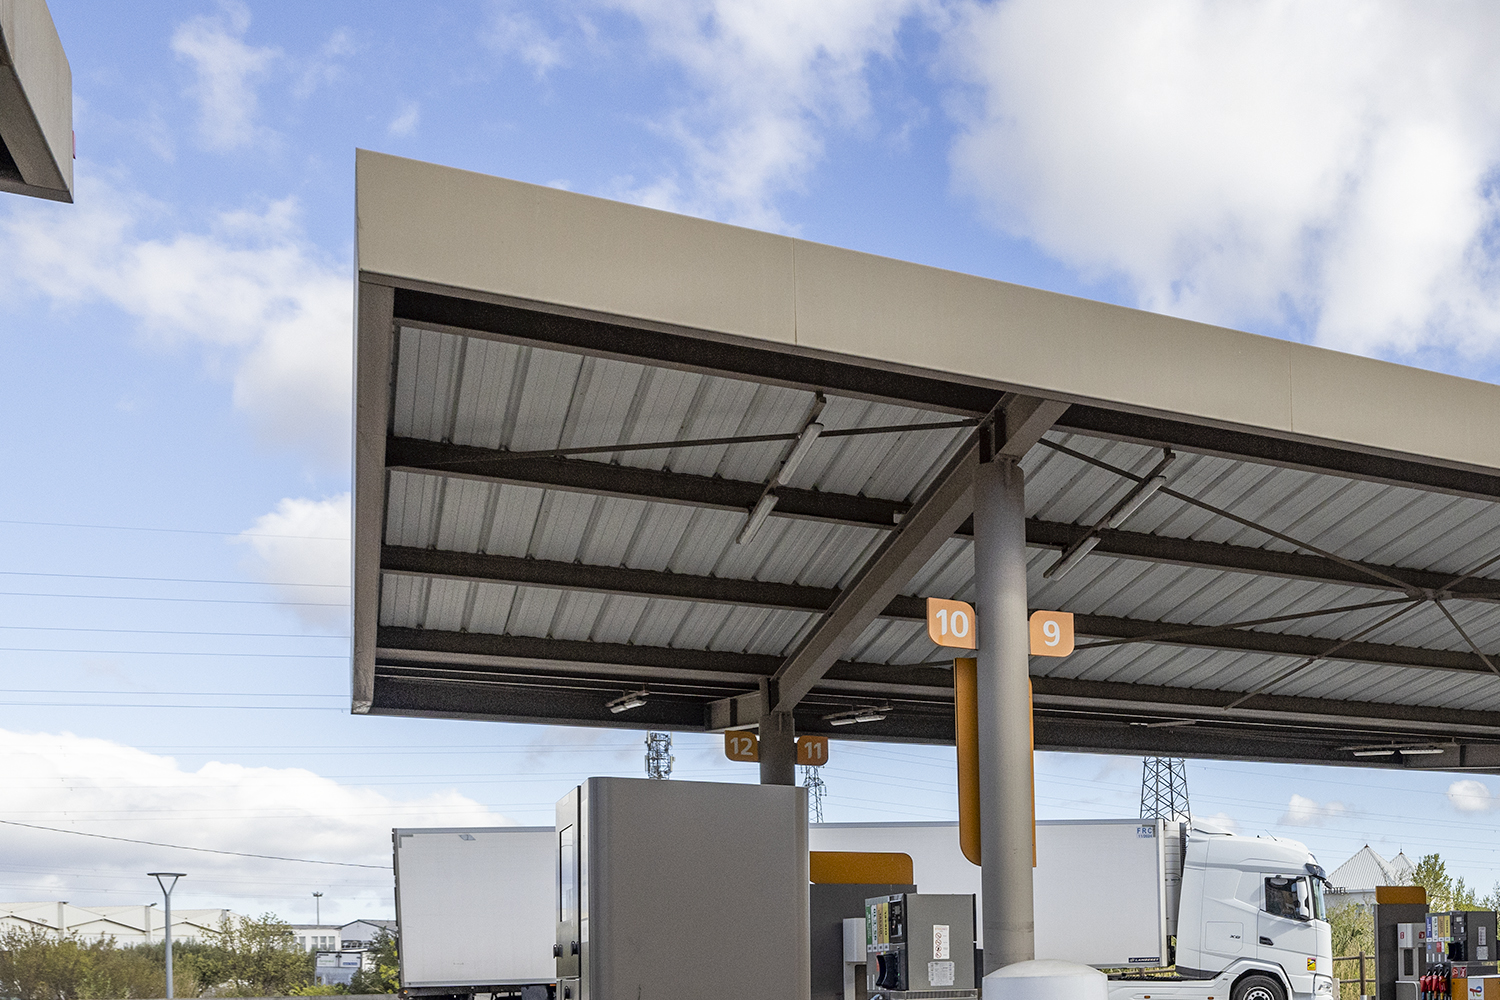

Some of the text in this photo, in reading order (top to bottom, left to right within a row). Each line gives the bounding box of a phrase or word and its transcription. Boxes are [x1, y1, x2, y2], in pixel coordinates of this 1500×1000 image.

[935, 608, 969, 638] 10
[1042, 620, 1061, 647] 9
[730, 737, 753, 756] 12
[804, 741, 822, 759] 11
